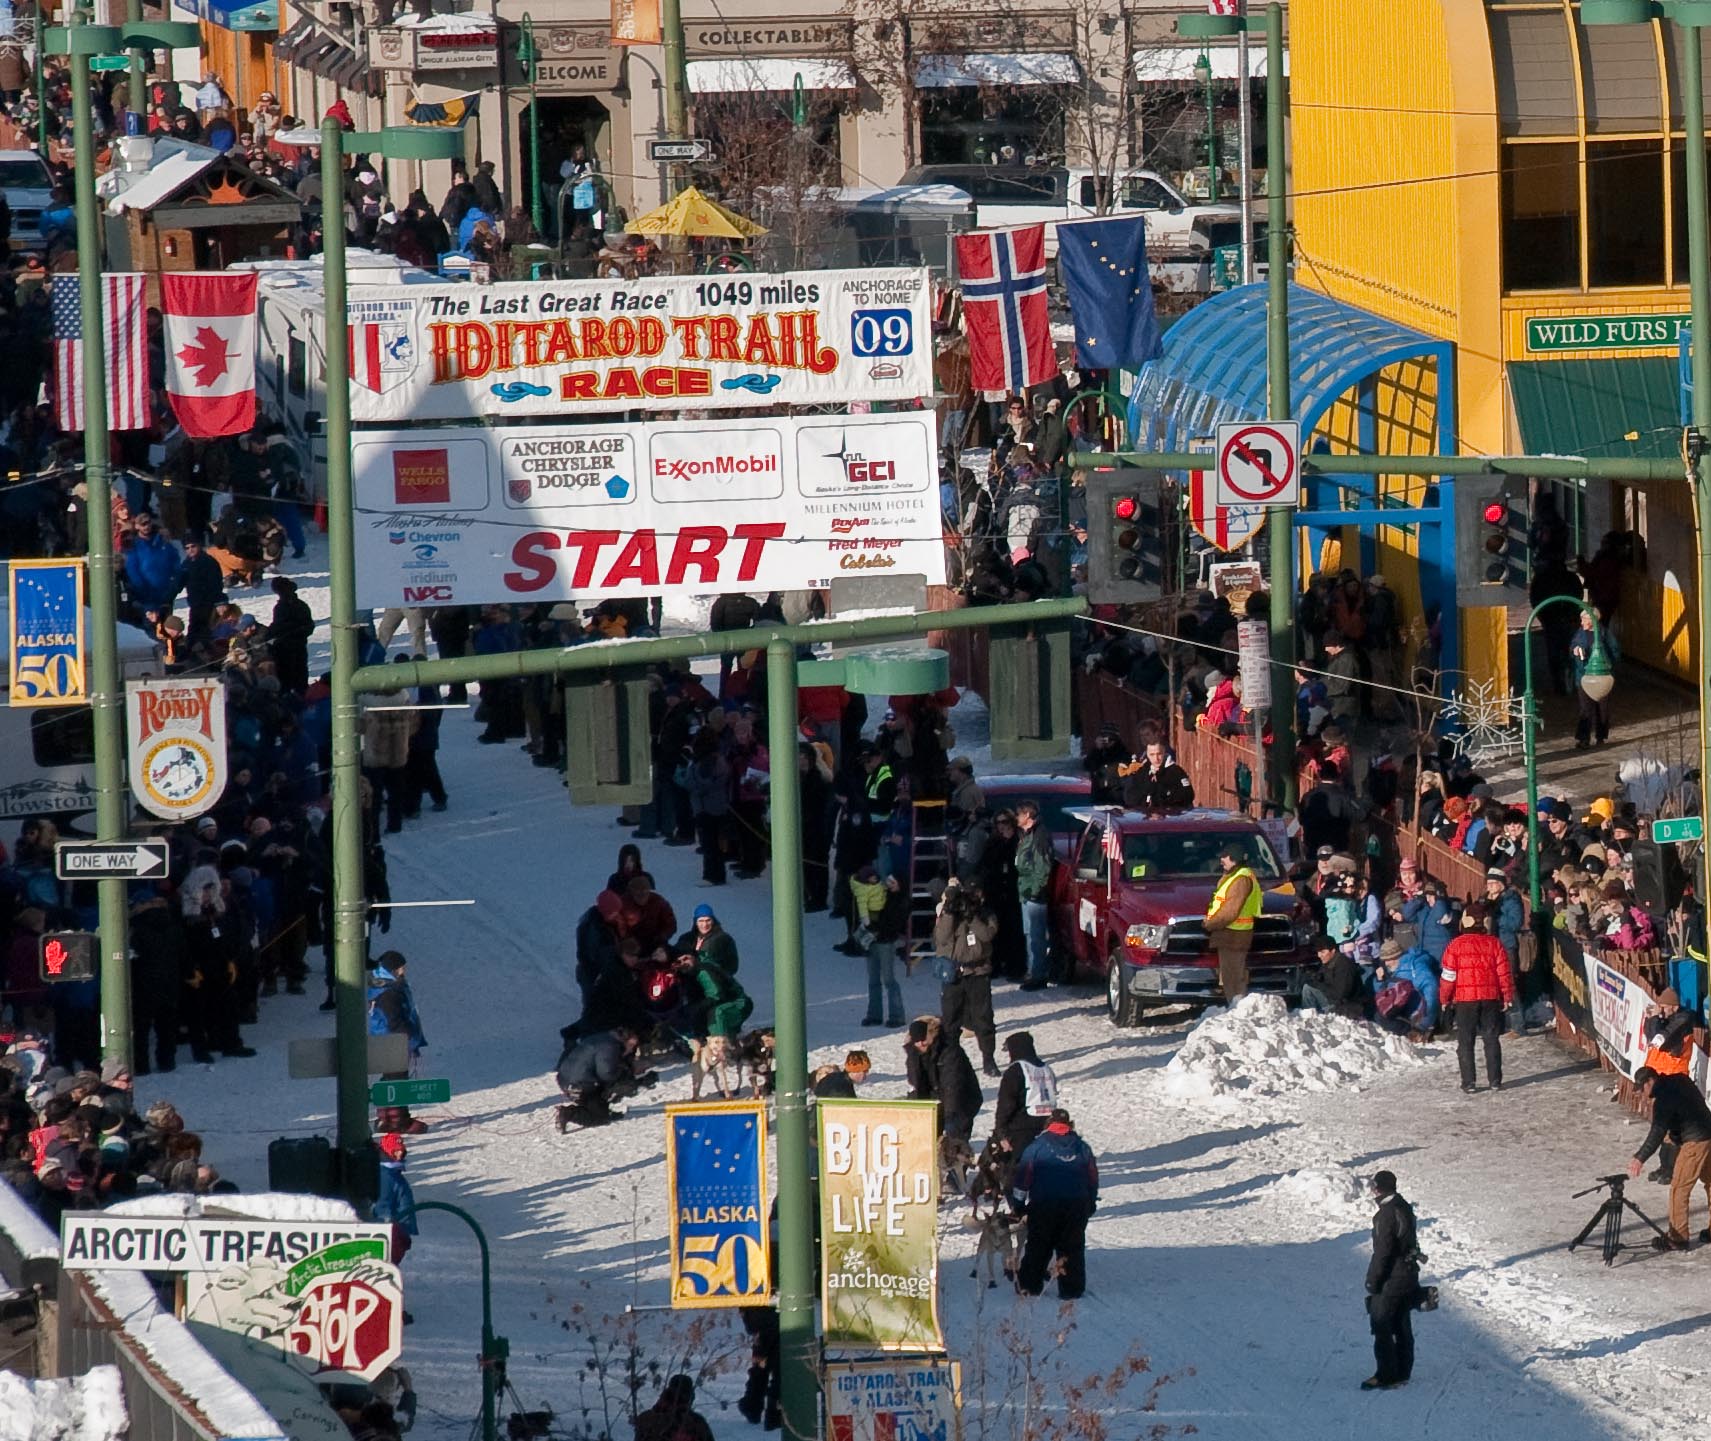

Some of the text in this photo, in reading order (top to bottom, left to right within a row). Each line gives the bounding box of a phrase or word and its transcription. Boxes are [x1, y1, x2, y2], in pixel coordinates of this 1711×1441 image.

[698, 30, 833, 46] COLLECTABLES
[475, 54, 493, 62] GIFTS
[657, 141, 694, 155] ONE WAY
[696, 279, 820, 307] 1049 miles
[842, 278, 921, 293] ANCHORAGE
[479, 293, 529, 315] Last
[538, 291, 602, 313] Great
[852, 292, 912, 306] TO NOME
[1535, 322, 1600, 345] WILD
[1605, 320, 1668, 342] FURS
[425, 309, 840, 387] IDITAROD TRAIL
[560, 366, 713, 401] RACE
[511, 438, 625, 458] ANCHORAGE
[398, 466, 446, 477] WELLS
[521, 455, 616, 473] CHRYSLER
[655, 454, 777, 482] ExxonMobil
[848, 460, 896, 483] GCI
[399, 475, 446, 487] FARGO
[537, 472, 601, 489] DODGE
[804, 499, 924, 514] MILLENNIUM HOTEL
[408, 531, 461, 542] Chevron
[828, 537, 904, 551] Fred Meyer
[503, 522, 787, 593] START
[840, 553, 896, 570] Cabela's
[410, 571, 458, 584] iridium
[403, 585, 454, 602] NAC
[16, 633, 77, 648] ALASKA
[15, 653, 79, 700] 50
[136, 687, 216, 747] RONDY
[0, 794, 93, 815] lowston
[1663, 824, 1672, 838] D
[72, 854, 137, 868] ONE WAY
[387, 1084, 396, 1102] D
[825, 1121, 901, 1175] BIG
[861, 1171, 931, 1205] WILD
[680, 1205, 758, 1224] ALASKA
[832, 1193, 905, 1236] LIFE
[67, 1227, 390, 1264] ARCTIC TREASU
[679, 1233, 763, 1298] 50
[290, 1260, 321, 1293] Arctic
[828, 1266, 931, 1292] anchorage
